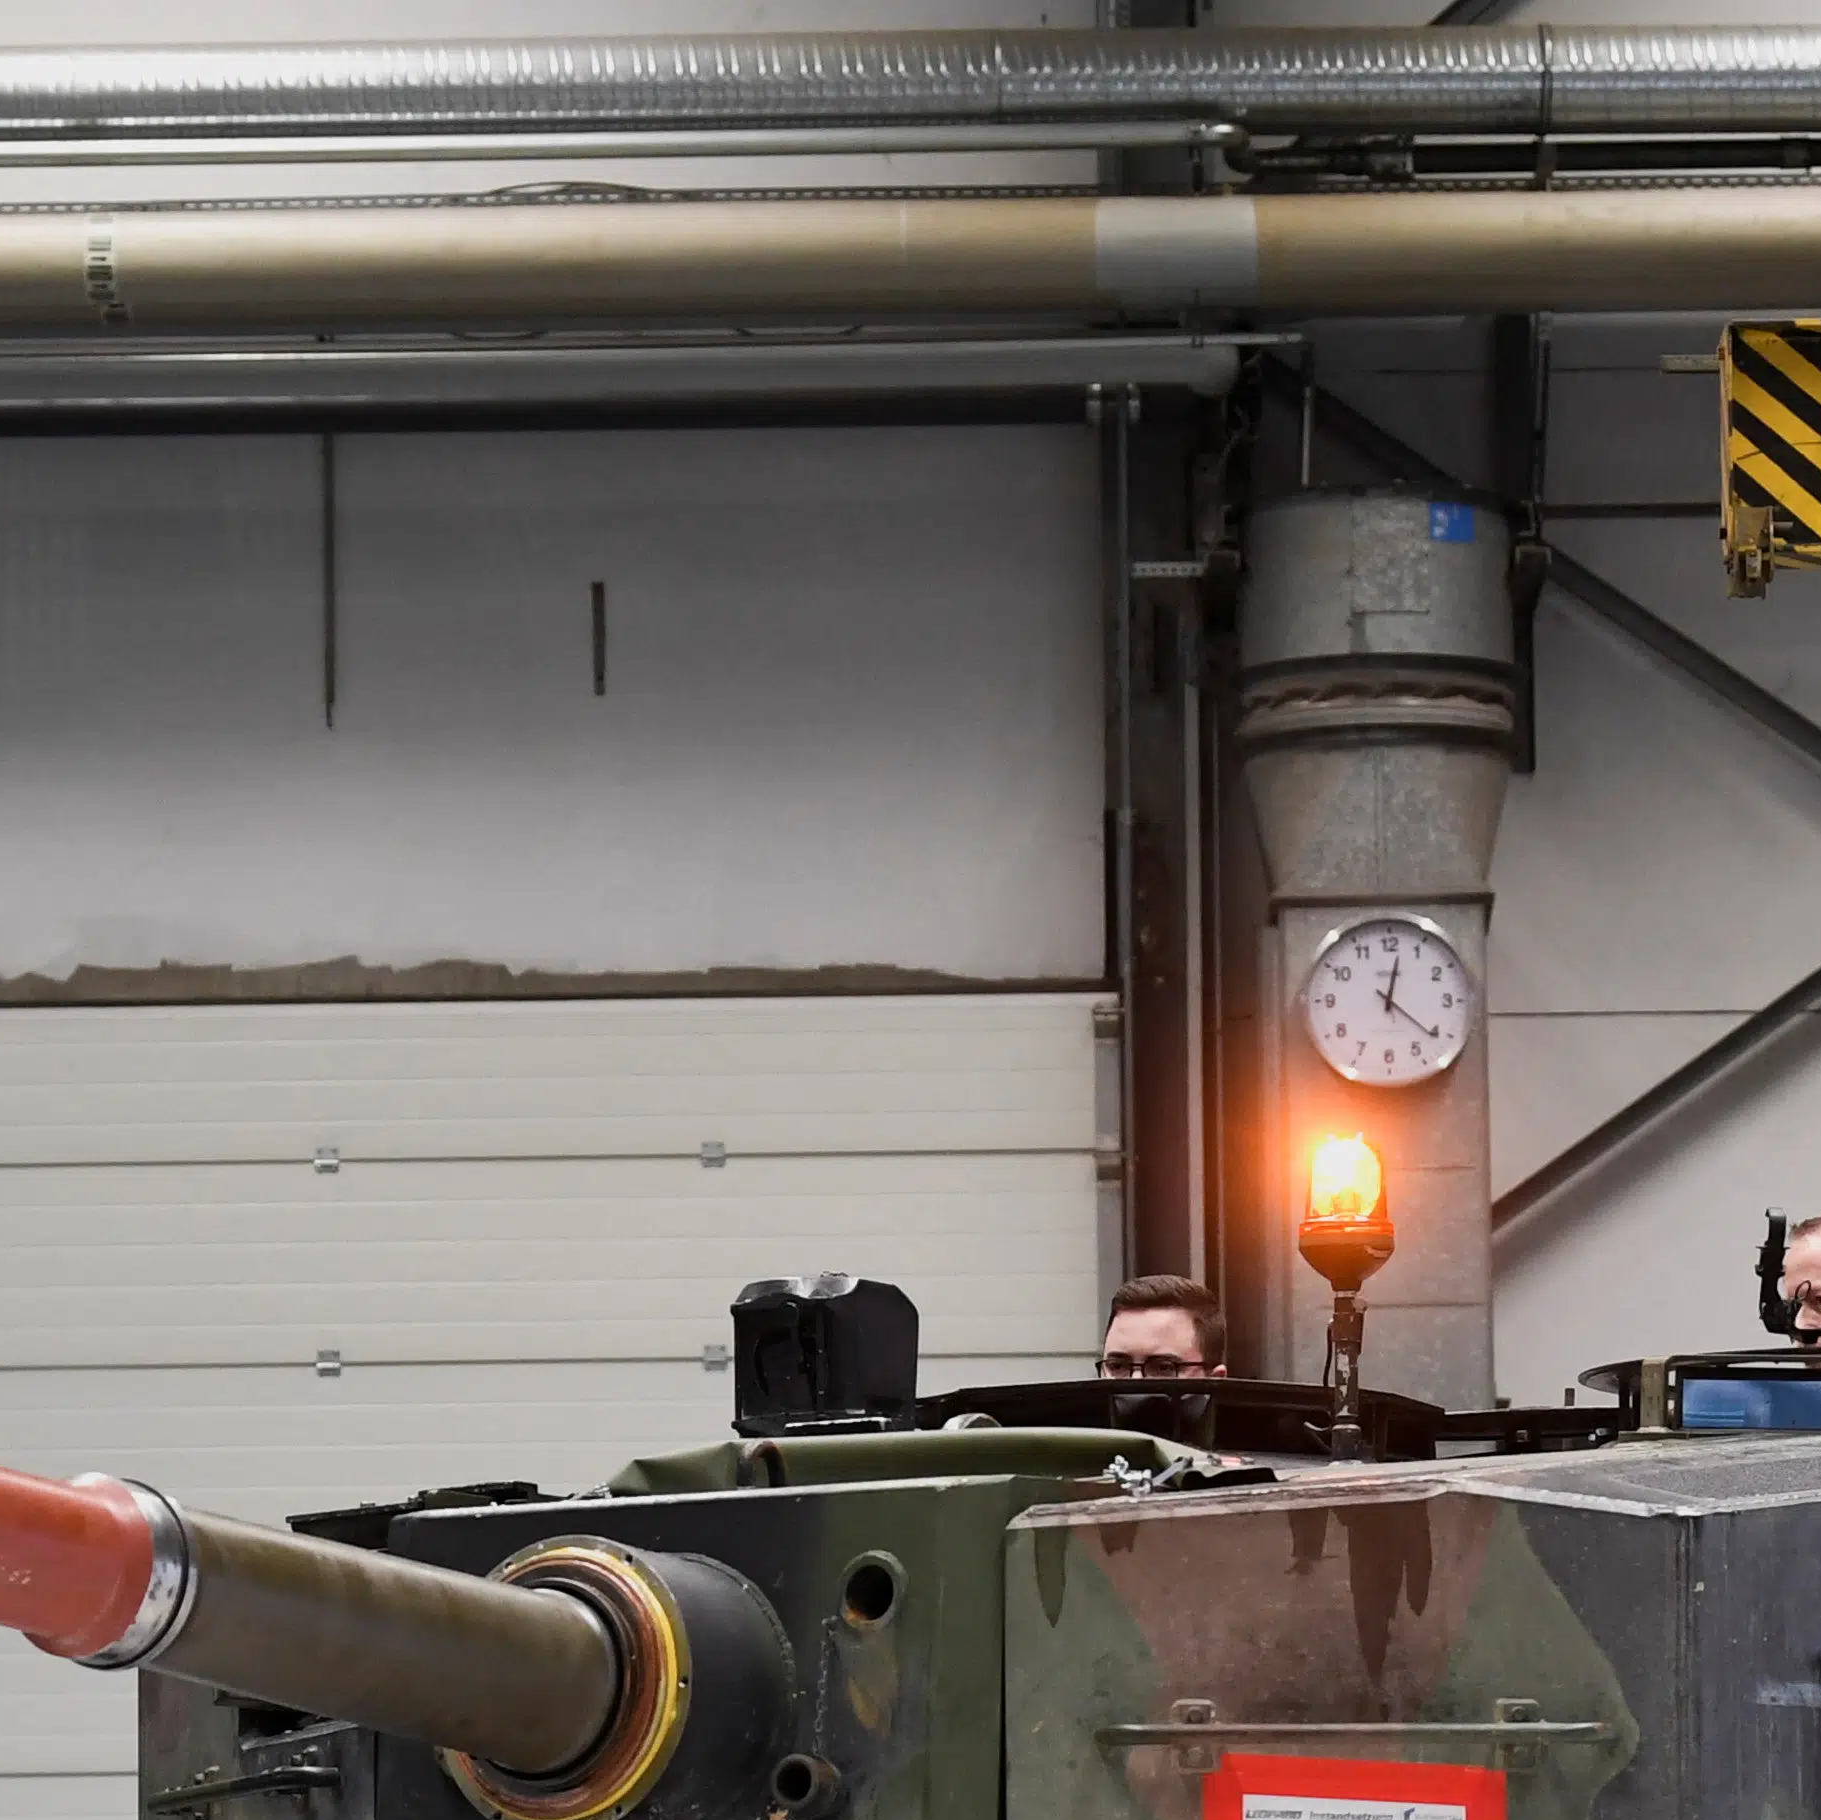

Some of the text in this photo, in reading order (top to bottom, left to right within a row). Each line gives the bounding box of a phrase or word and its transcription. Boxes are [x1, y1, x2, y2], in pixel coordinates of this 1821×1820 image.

[1382, 937, 1398, 951] 12
[1357, 946, 1369, 959] 11
[1414, 945, 1420, 958] 1
[1333, 967, 1350, 980] 10
[1431, 967, 1441, 980] 2
[1325, 994, 1335, 1007] 9
[1442, 994, 1452, 1007] 3
[1336, 1023, 1345, 1038] 8
[1430, 1025, 1438, 1038] 4
[1357, 1041, 1366, 1056] 7
[1411, 1042, 1420, 1056] 5
[1384, 1050, 1393, 1064] 6
